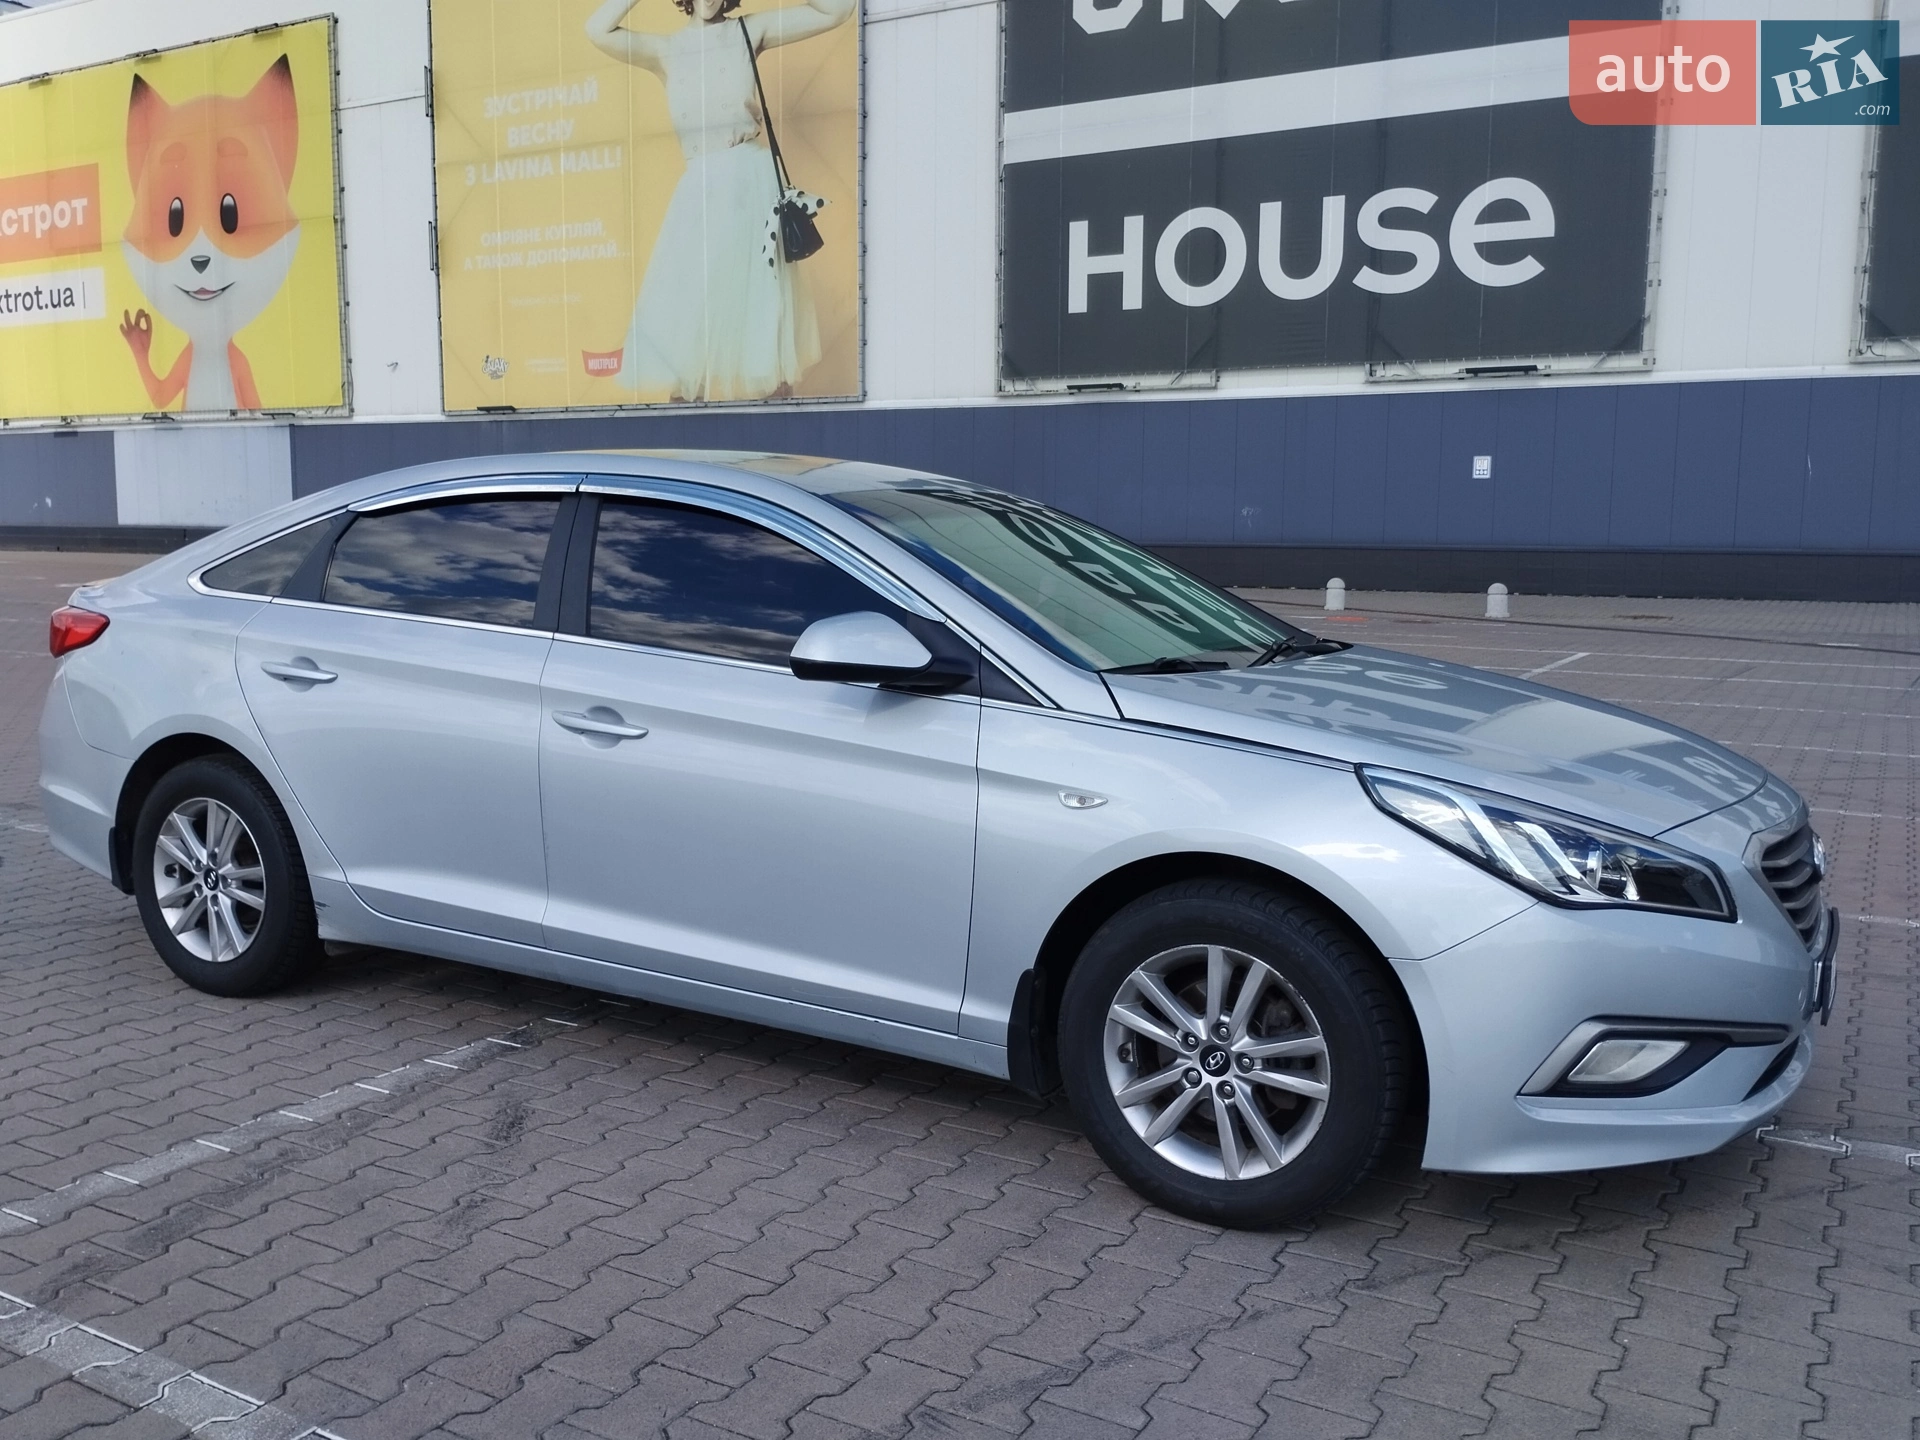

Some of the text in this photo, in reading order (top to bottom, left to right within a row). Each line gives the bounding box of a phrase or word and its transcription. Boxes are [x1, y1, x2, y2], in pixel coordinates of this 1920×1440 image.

[484, 75, 598, 119] ЗУСТРІЧАЙ
[507, 118, 574, 148] ВЕСНУ
[481, 154, 553, 184] LAVINA
[560, 145, 622, 175] MALL!
[0, 198, 88, 239] строт
[0, 285, 75, 314] trot.ua
[588, 357, 618, 371] MULTIPLEX
